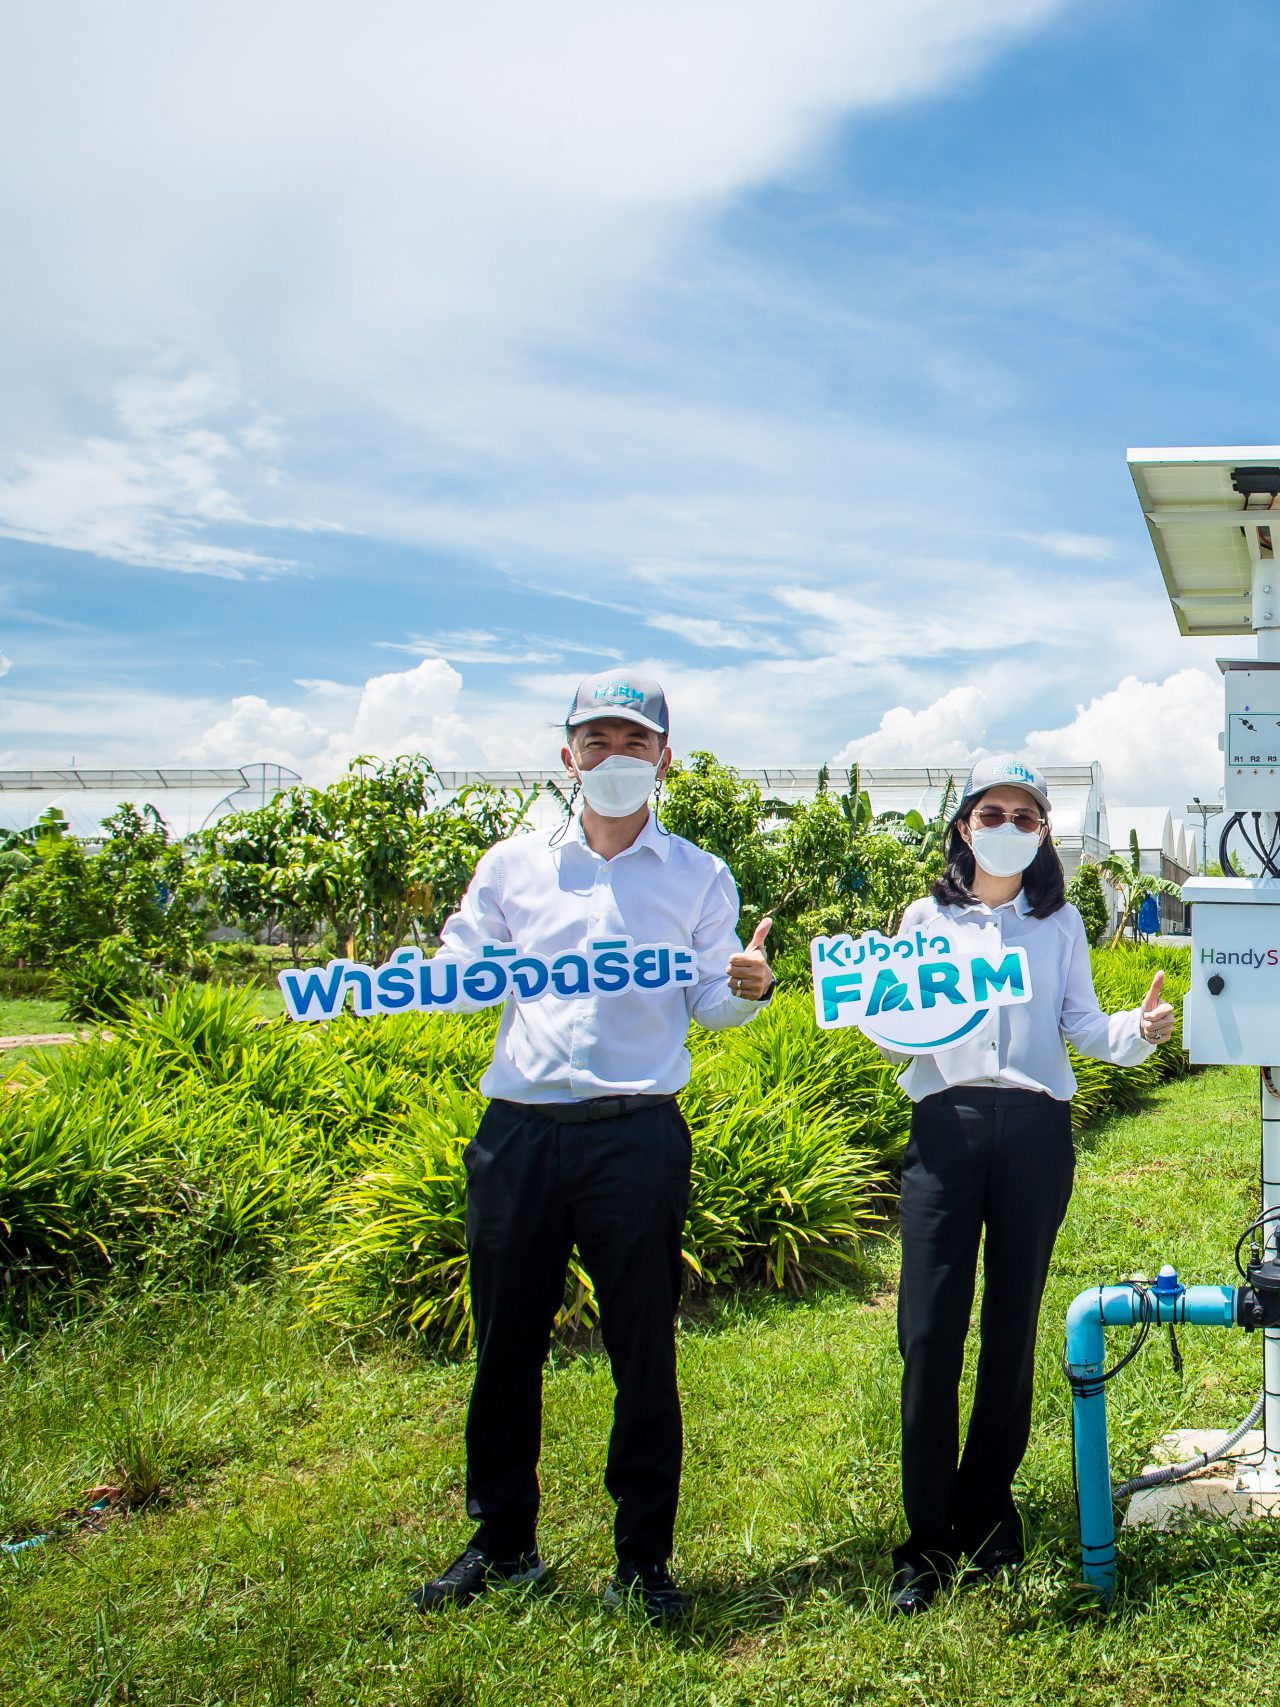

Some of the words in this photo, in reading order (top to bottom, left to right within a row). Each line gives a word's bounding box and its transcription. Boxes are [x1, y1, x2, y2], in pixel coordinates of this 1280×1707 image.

[1234, 755, 1244, 763] R1
[1250, 755, 1261, 763] R2
[1267, 755, 1278, 763] R3
[817, 930, 951, 968] Kubota
[285, 939, 694, 1016] ฟาร์มอัจฉริยะ
[821, 952, 1026, 1023] FARM
